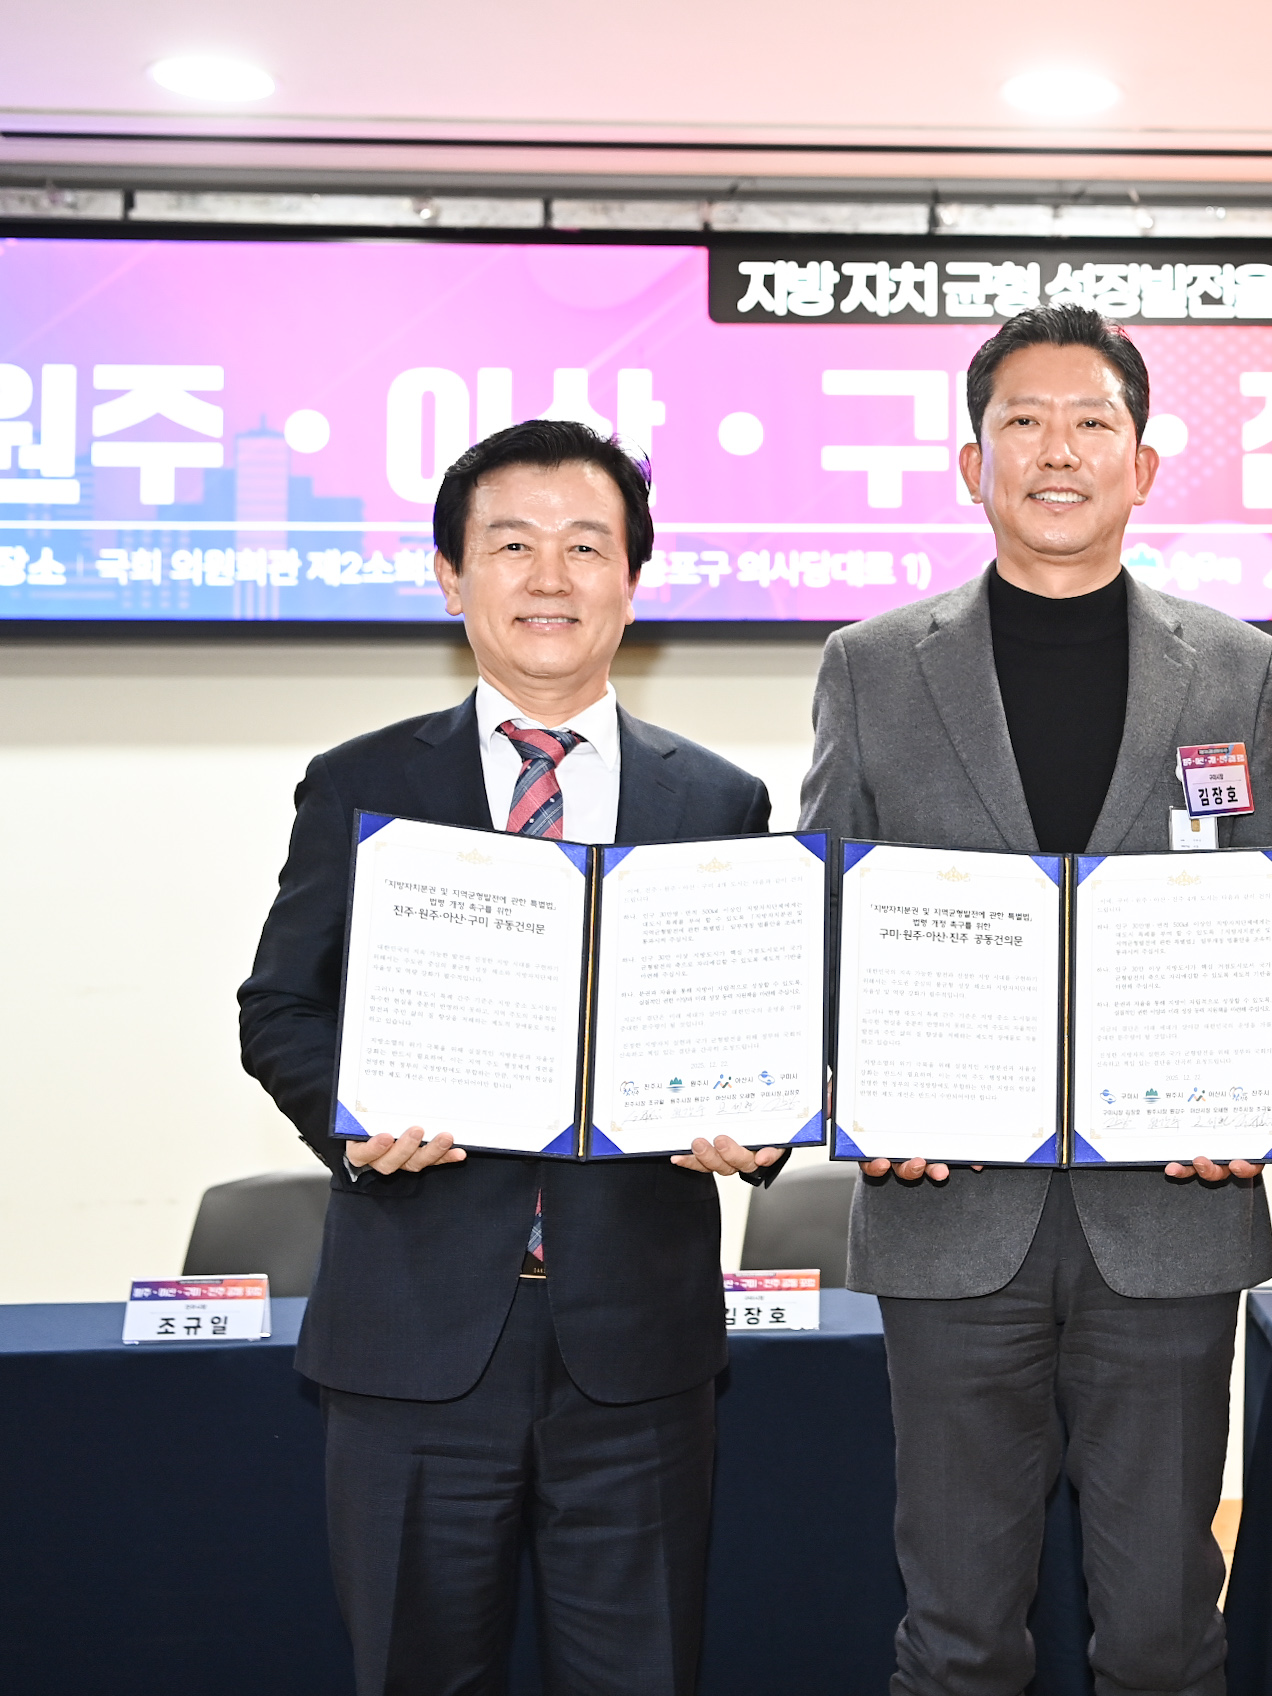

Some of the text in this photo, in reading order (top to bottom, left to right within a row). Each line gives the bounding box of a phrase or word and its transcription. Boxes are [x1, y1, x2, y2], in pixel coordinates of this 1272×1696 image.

[736, 260, 839, 317] 지방
[840, 261, 941, 318] 자치
[943, 262, 1040, 317] 균형
[0, 363, 225, 505] 원주
[821, 369, 978, 510] 구
[96, 547, 162, 587] 국회
[169, 547, 302, 587] 의원회관
[1198, 786, 1238, 806] 김장호
[496, 906, 513, 917] 위한
[493, 917, 546, 936] 공동건의문
[975, 922, 992, 932] 위한
[973, 933, 1024, 947] 공동건의문
[735, 1076, 753, 1084] 아산시
[1121, 1092, 1139, 1100] 구미시
[1166, 1091, 1184, 1099] 원주시
[157, 1316, 228, 1336] 조규일
